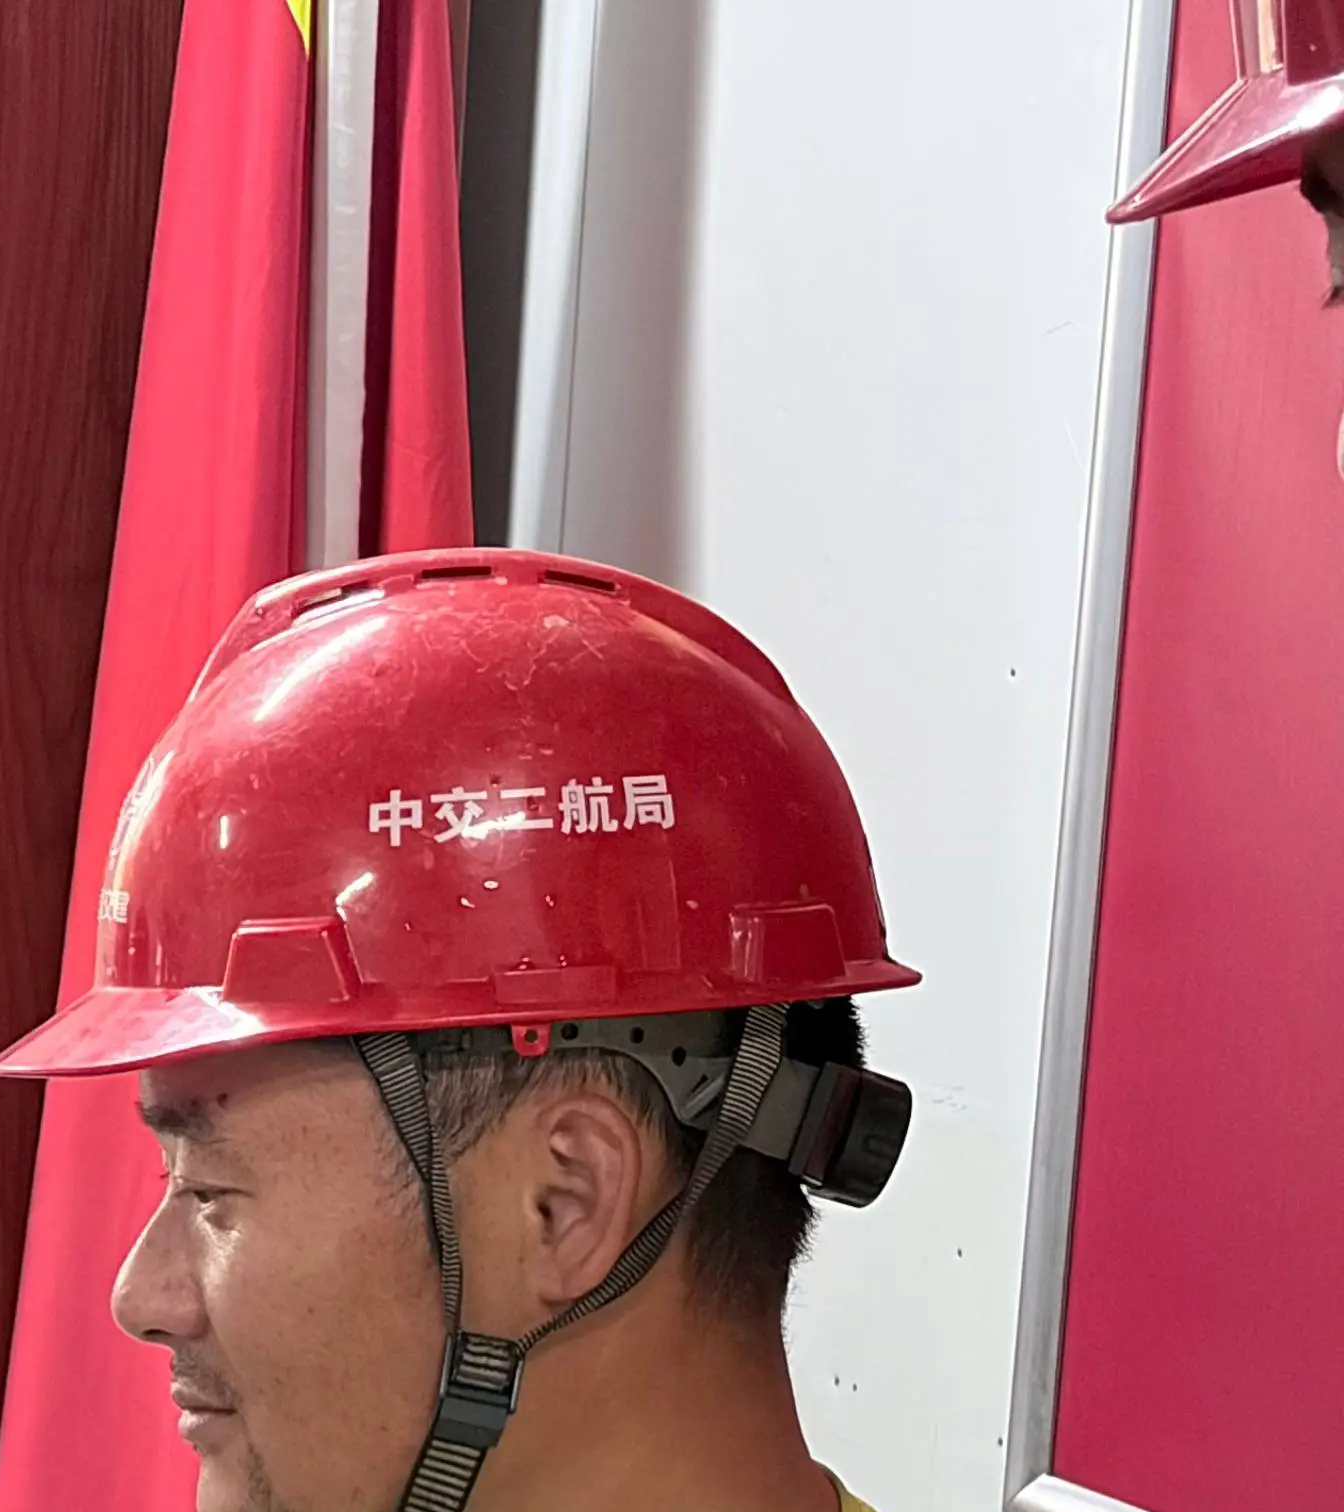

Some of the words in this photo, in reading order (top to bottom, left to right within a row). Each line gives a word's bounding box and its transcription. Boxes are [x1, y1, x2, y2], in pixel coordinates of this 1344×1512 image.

[368, 774, 676, 847] 中交二航局
